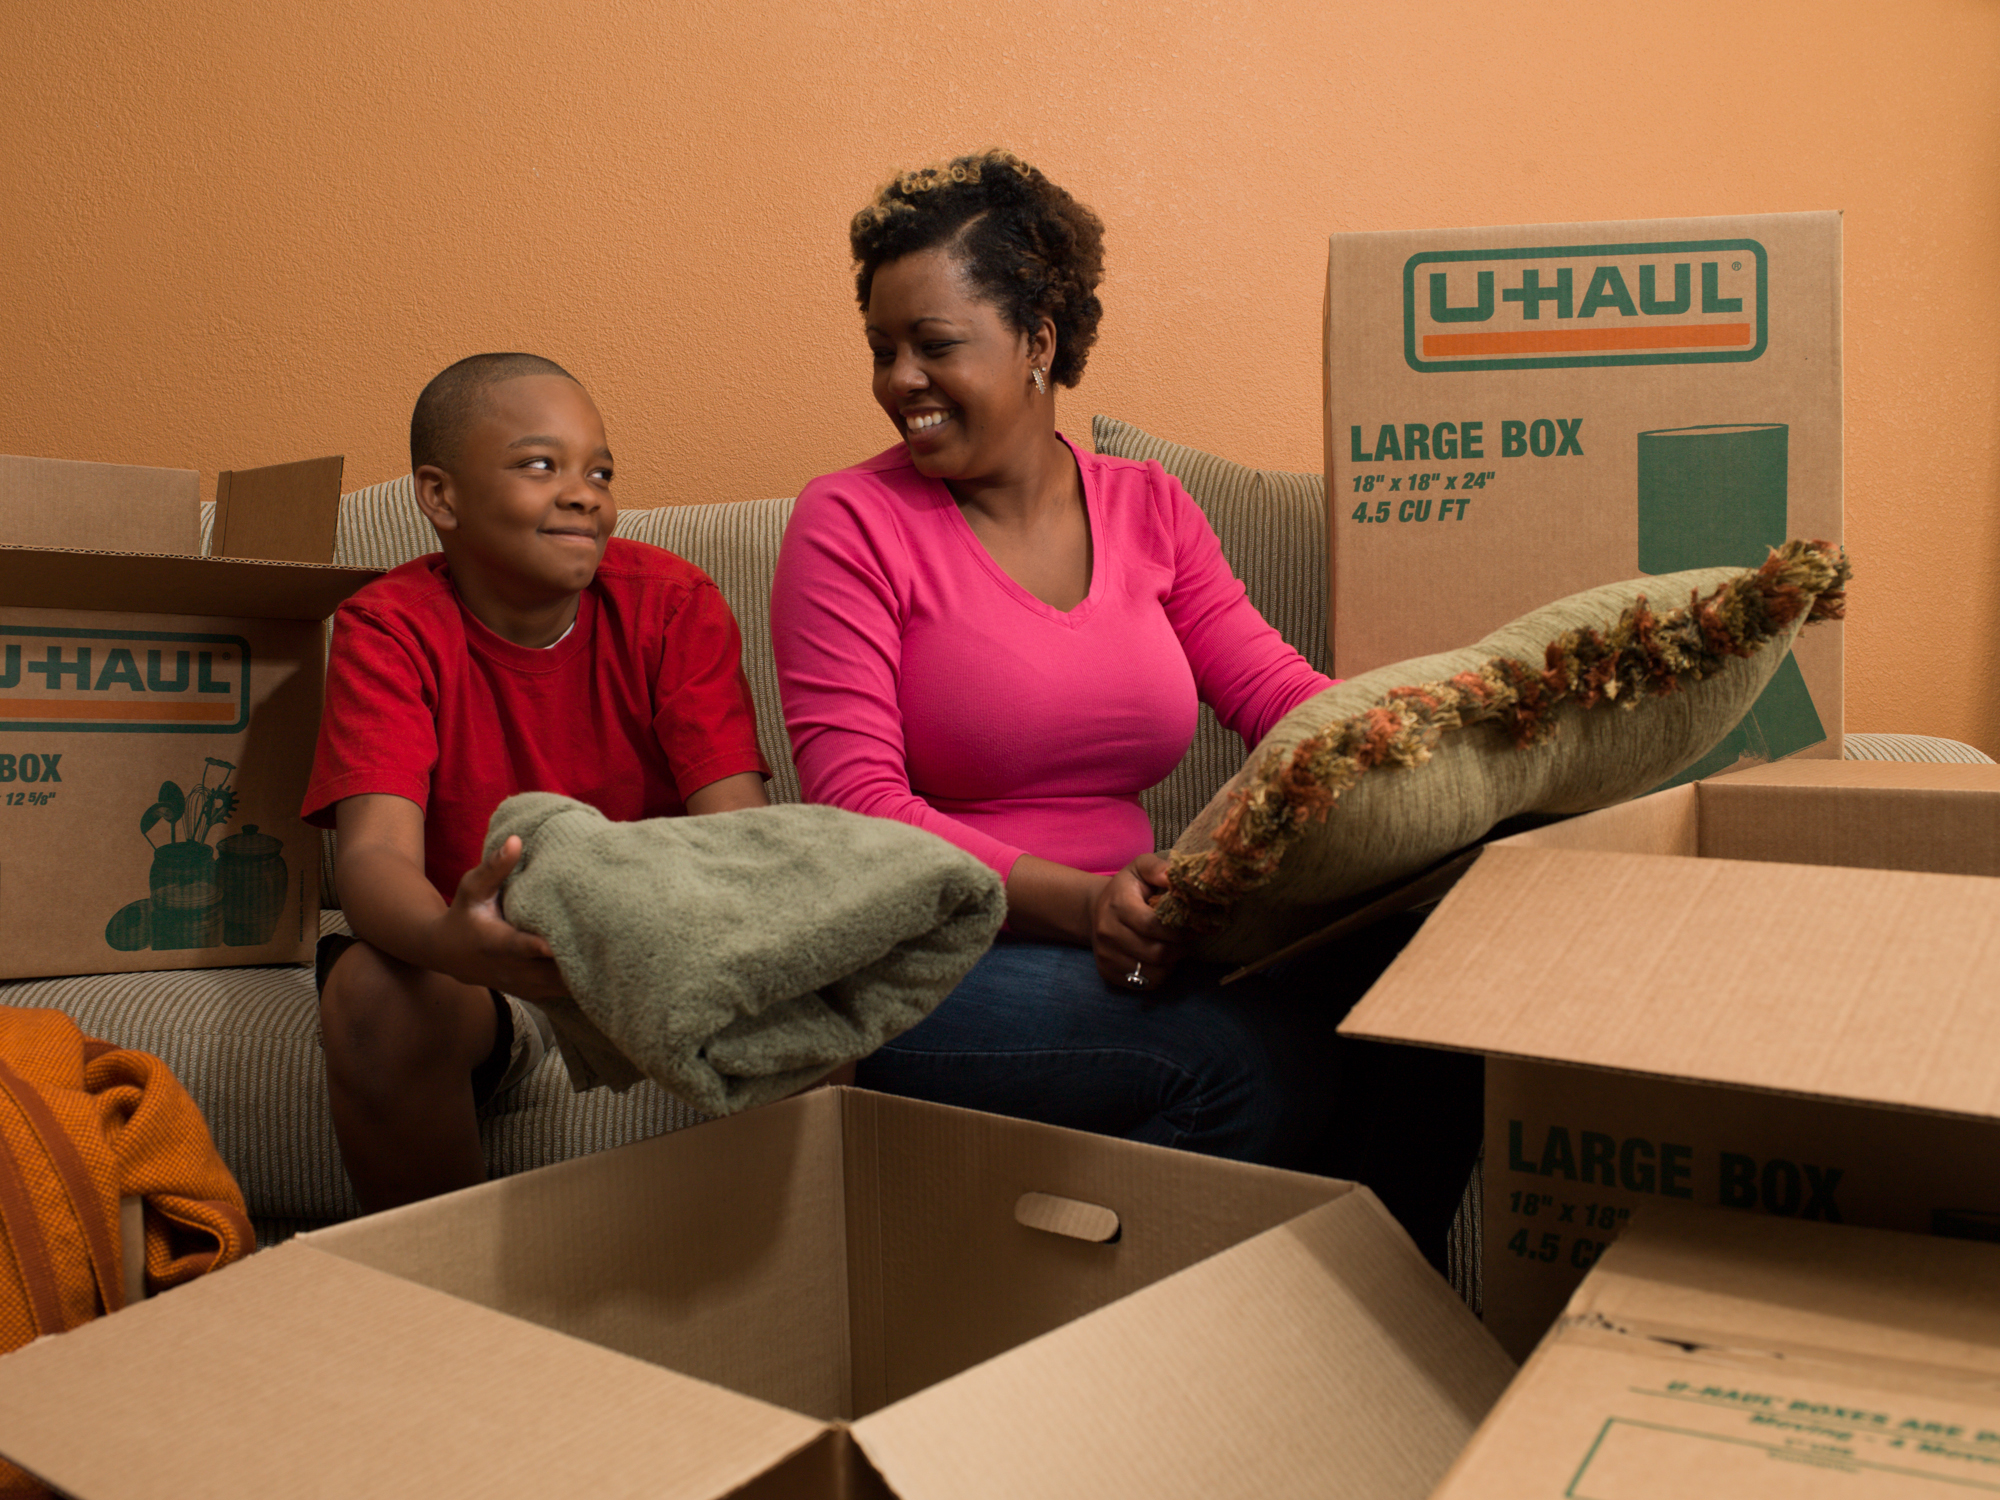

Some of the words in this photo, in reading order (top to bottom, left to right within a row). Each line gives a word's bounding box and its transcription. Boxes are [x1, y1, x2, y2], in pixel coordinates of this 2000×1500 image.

[1350, 421, 1484, 463] LARGE
[1501, 418, 1585, 459] BOX
[1352, 475, 1386, 493] 18"
[1388, 477, 1403, 492] x
[1408, 473, 1441, 491] 18"
[1444, 475, 1459, 490] x
[1461, 471, 1496, 490] 24"
[1351, 501, 1392, 523] 4.5
[1398, 499, 1433, 523] CU
[1437, 498, 1471, 522] FT
[1508, 1119, 1694, 1201] LARGE
[1718, 1151, 1845, 1225] BOX
[1510, 1190, 1554, 1217] 18"
[1586, 1202, 1630, 1230] 18"
[1507, 1227, 1562, 1263] 4.5
